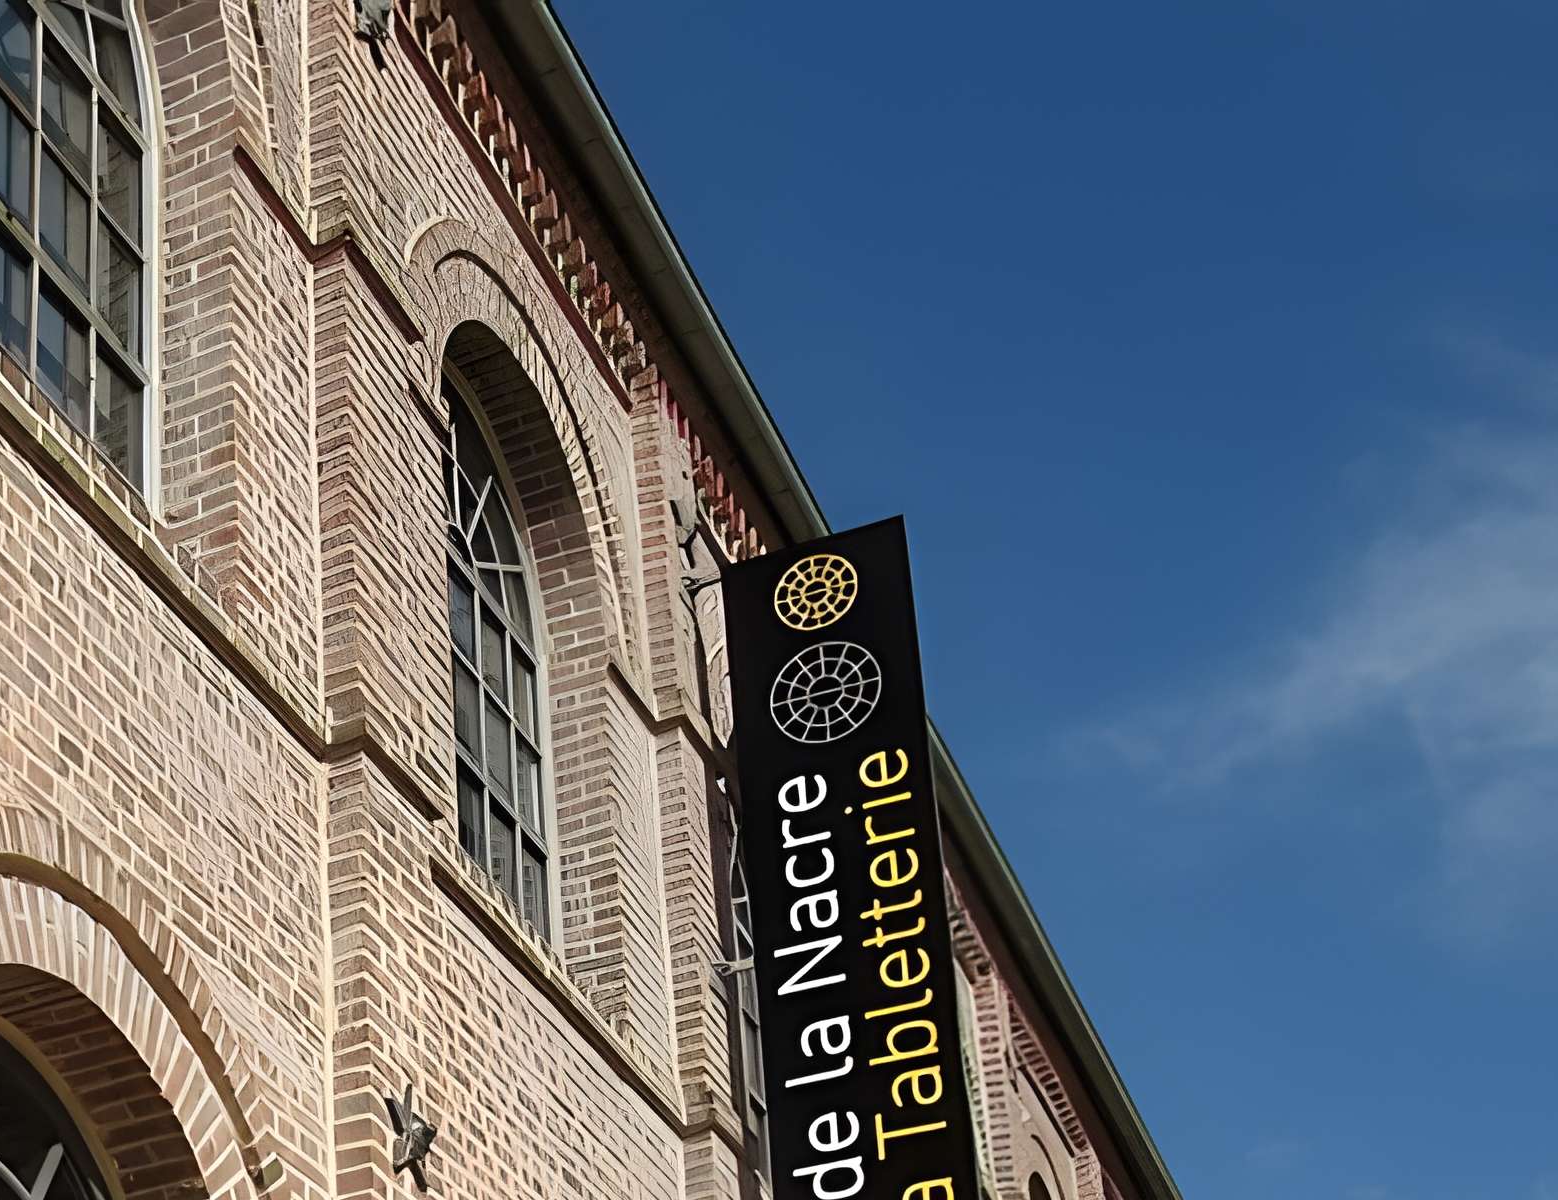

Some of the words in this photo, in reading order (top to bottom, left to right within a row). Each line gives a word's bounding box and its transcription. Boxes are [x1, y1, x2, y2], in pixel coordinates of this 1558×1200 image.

[773, 774, 847, 996] Nacre
[844, 748, 947, 1161] Tabletterie
[784, 1014, 854, 1088] la
[792, 1111, 865, 1200] de
